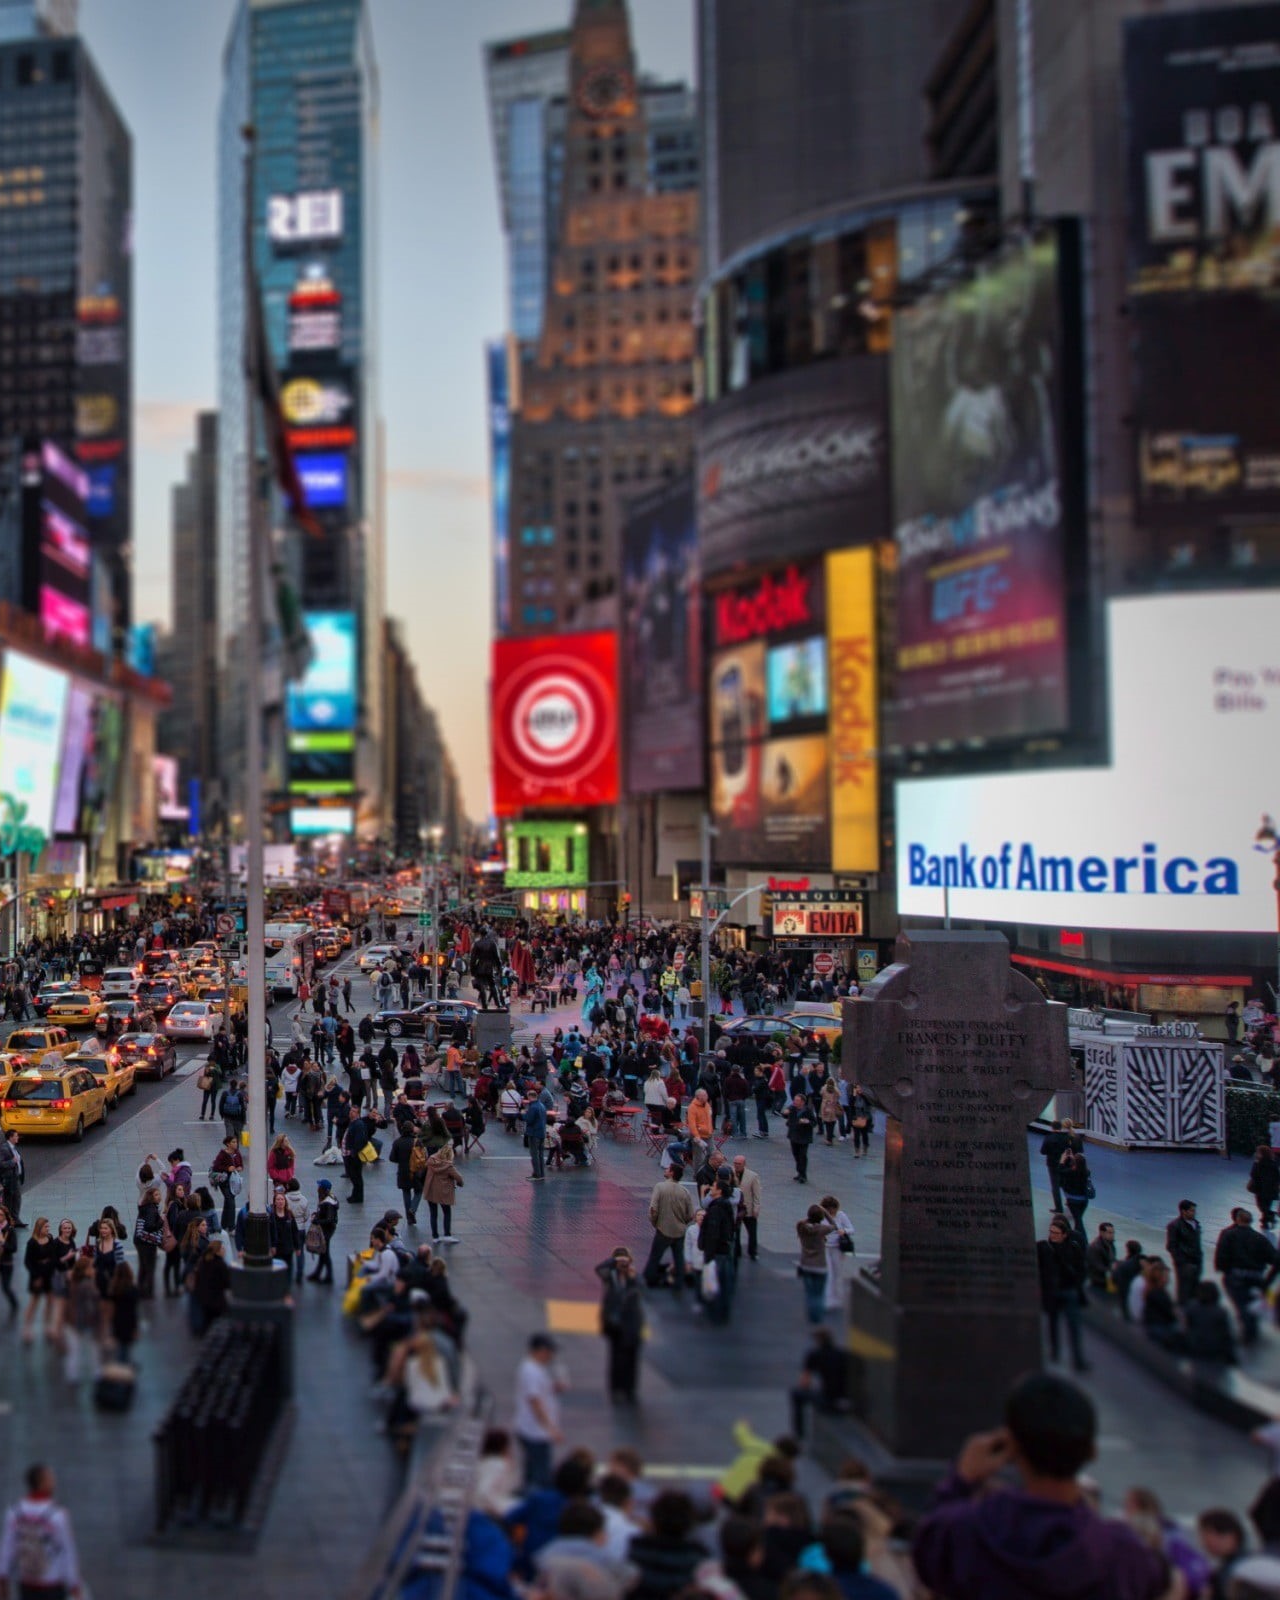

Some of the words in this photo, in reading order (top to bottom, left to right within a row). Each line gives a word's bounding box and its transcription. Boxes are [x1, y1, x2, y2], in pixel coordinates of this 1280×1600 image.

[834, 636, 873, 788] Kodak
[908, 842, 977, 888] Bank
[981, 842, 1012, 890] of
[1016, 842, 1240, 895] America
[772, 892, 864, 900] MARQUIS
[809, 911, 858, 934] EVITA
[1137, 1024, 1173, 1037] snack
[1174, 1023, 1200, 1038] BOX
[898, 1031, 957, 1045] FRANCIS
[977, 1033, 1028, 1047] DUFFY
[915, 1064, 966, 1074] CATHOLIC
[973, 1065, 1012, 1075] PRIEST
[938, 1088, 989, 1098] CHAPLAIN
[967, 1161, 1018, 1171] COUNTRY
